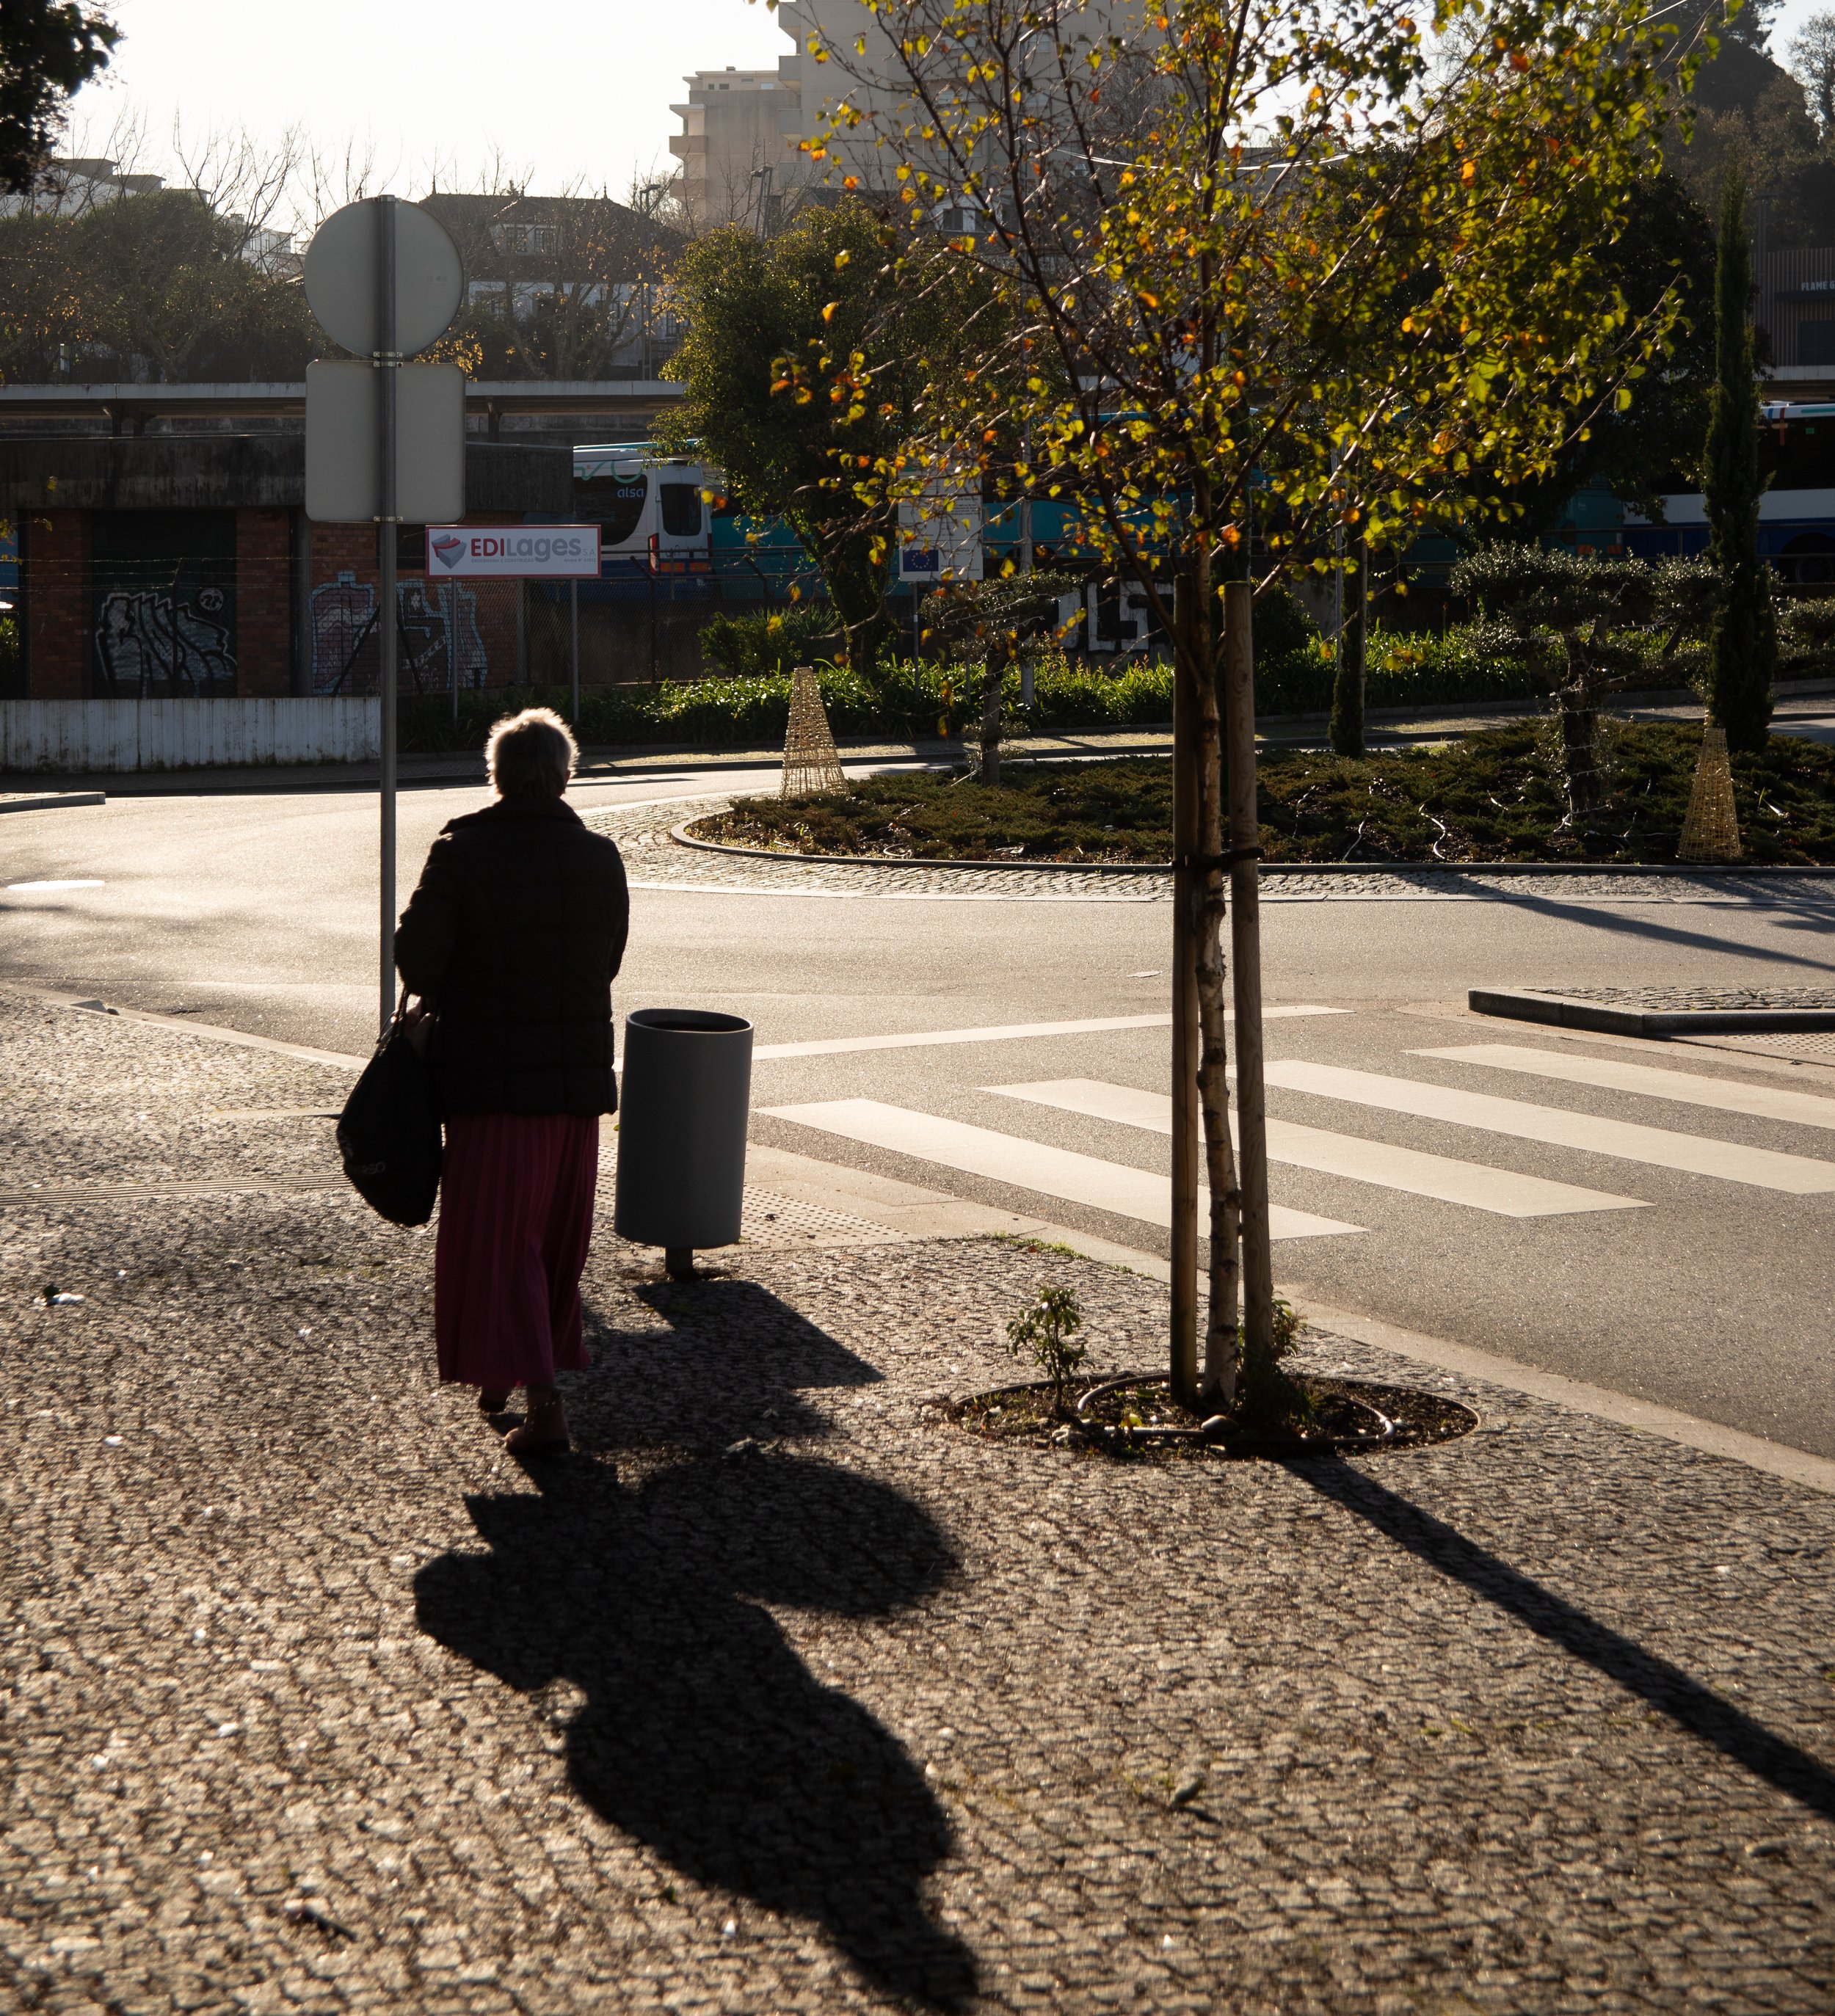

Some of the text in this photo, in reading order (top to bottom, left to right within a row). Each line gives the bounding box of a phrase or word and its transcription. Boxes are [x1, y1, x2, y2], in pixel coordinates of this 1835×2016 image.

[1801, 281, 1828, 291] FLAME
[617, 487, 644, 498] alsa
[470, 538, 581, 562] EDILages
